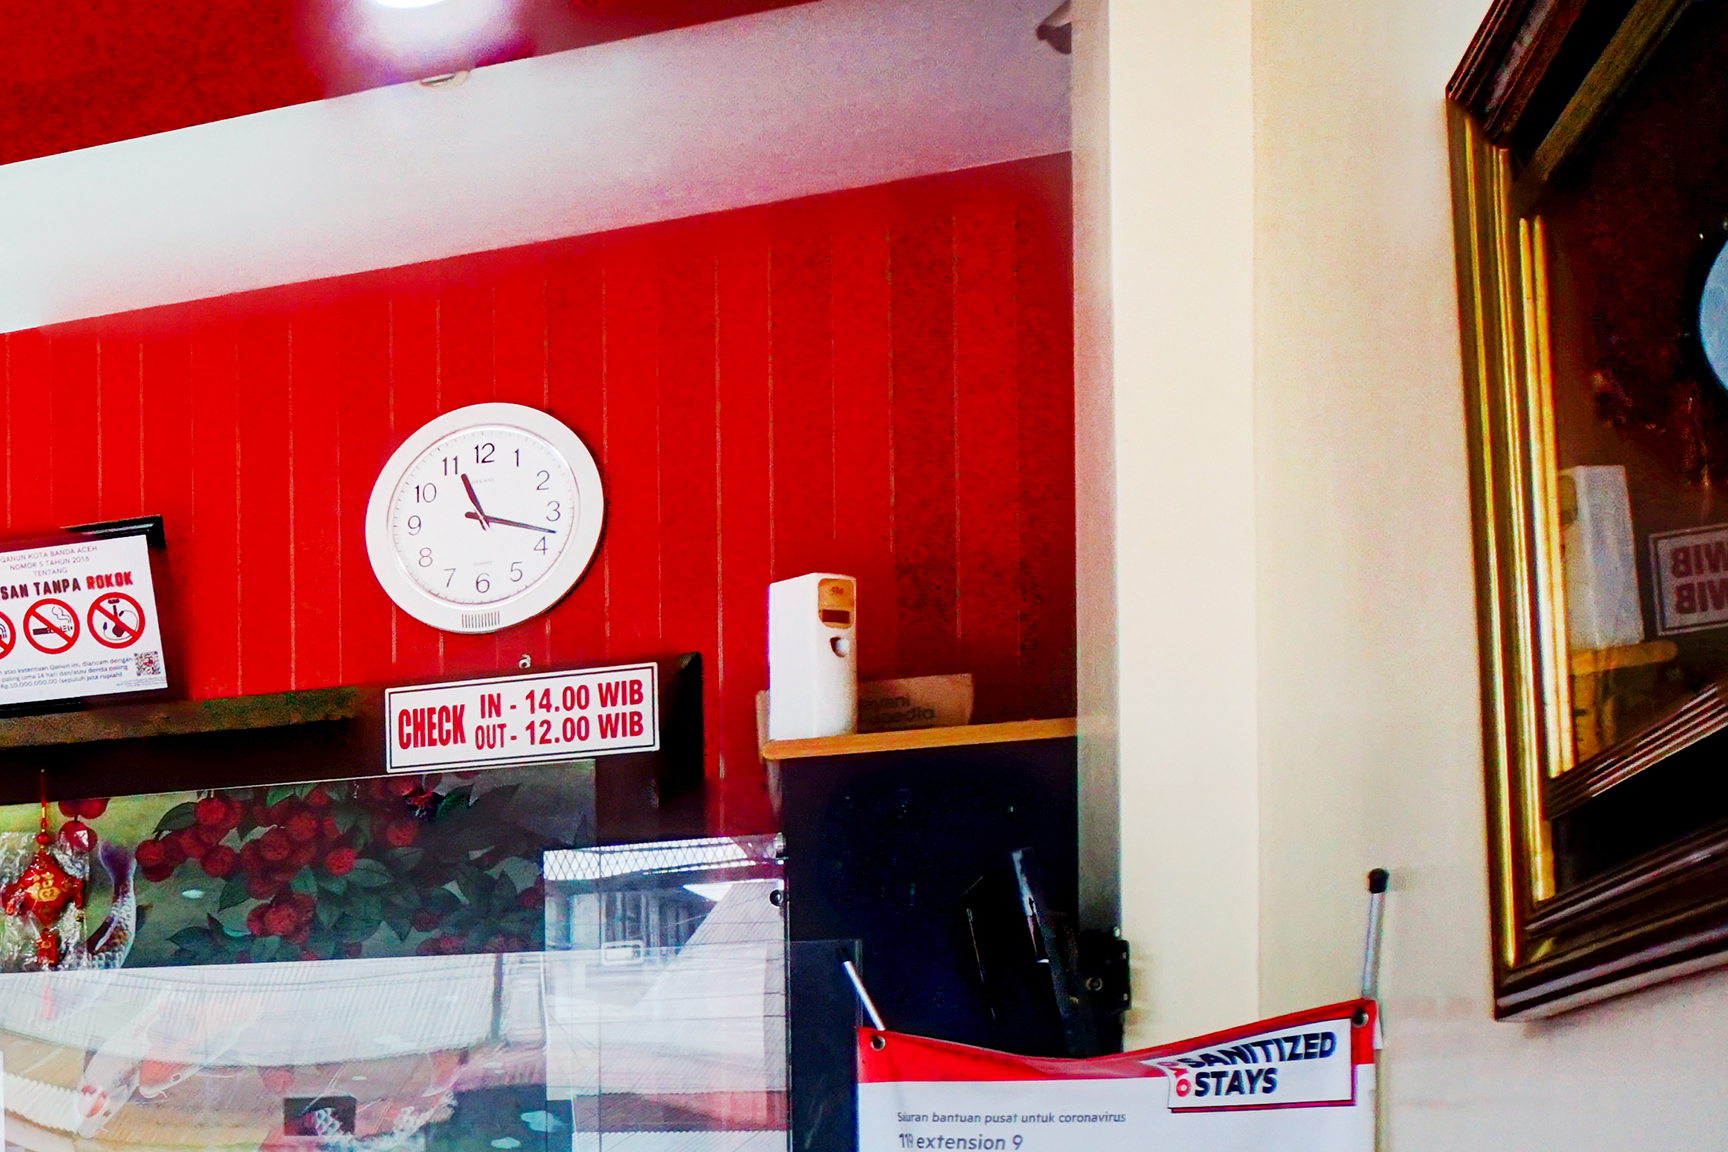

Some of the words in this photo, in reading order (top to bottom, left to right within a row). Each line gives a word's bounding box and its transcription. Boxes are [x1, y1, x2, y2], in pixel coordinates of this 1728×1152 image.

[474, 443, 495, 463] 12
[514, 449, 520, 467] 1
[442, 456, 458, 476] 11
[536, 470, 550, 490] 2
[415, 483, 437, 503] 10
[546, 501, 561, 522] 3
[408, 515, 421, 535] 9
[0, 555, 26, 563] QANUN
[28, 552, 48, 560] KOTA
[50, 548, 75, 557] BANDA
[77, 546, 97, 555] ACEH
[533, 536, 549, 555] 4
[10, 562, 37, 571] NOMOR
[45, 558, 70, 566] TAHUN
[418, 547, 433, 567] 8
[34, 568, 68, 576] TENTANG
[443, 568, 456, 587] 7
[510, 561, 523, 582] 5
[33, 578, 81, 596] TANPA
[86, 571, 133, 590] ROKOK
[476, 573, 490, 593] 6
[398, 704, 466, 749] CHECK
[480, 693, 501, 719] IN
[525, 685, 590, 714] 14.00
[598, 679, 644, 707] WIB
[475, 723, 506, 750] OUT
[525, 716, 590, 745] 12.00
[598, 711, 644, 739] WIB
[1177, 1031, 1337, 1068] SANITIZED
[1195, 1067, 1278, 1096] STAYS
[932, 1112, 981, 1123] bantuan
[985, 1113, 1017, 1124] pusat
[1022, 1112, 1055, 1123] untuk
[1059, 1112, 1126, 1123] coronavirus
[917, 1134, 1006, 1150] extension
[1012, 1135, 1023, 1150] 9
